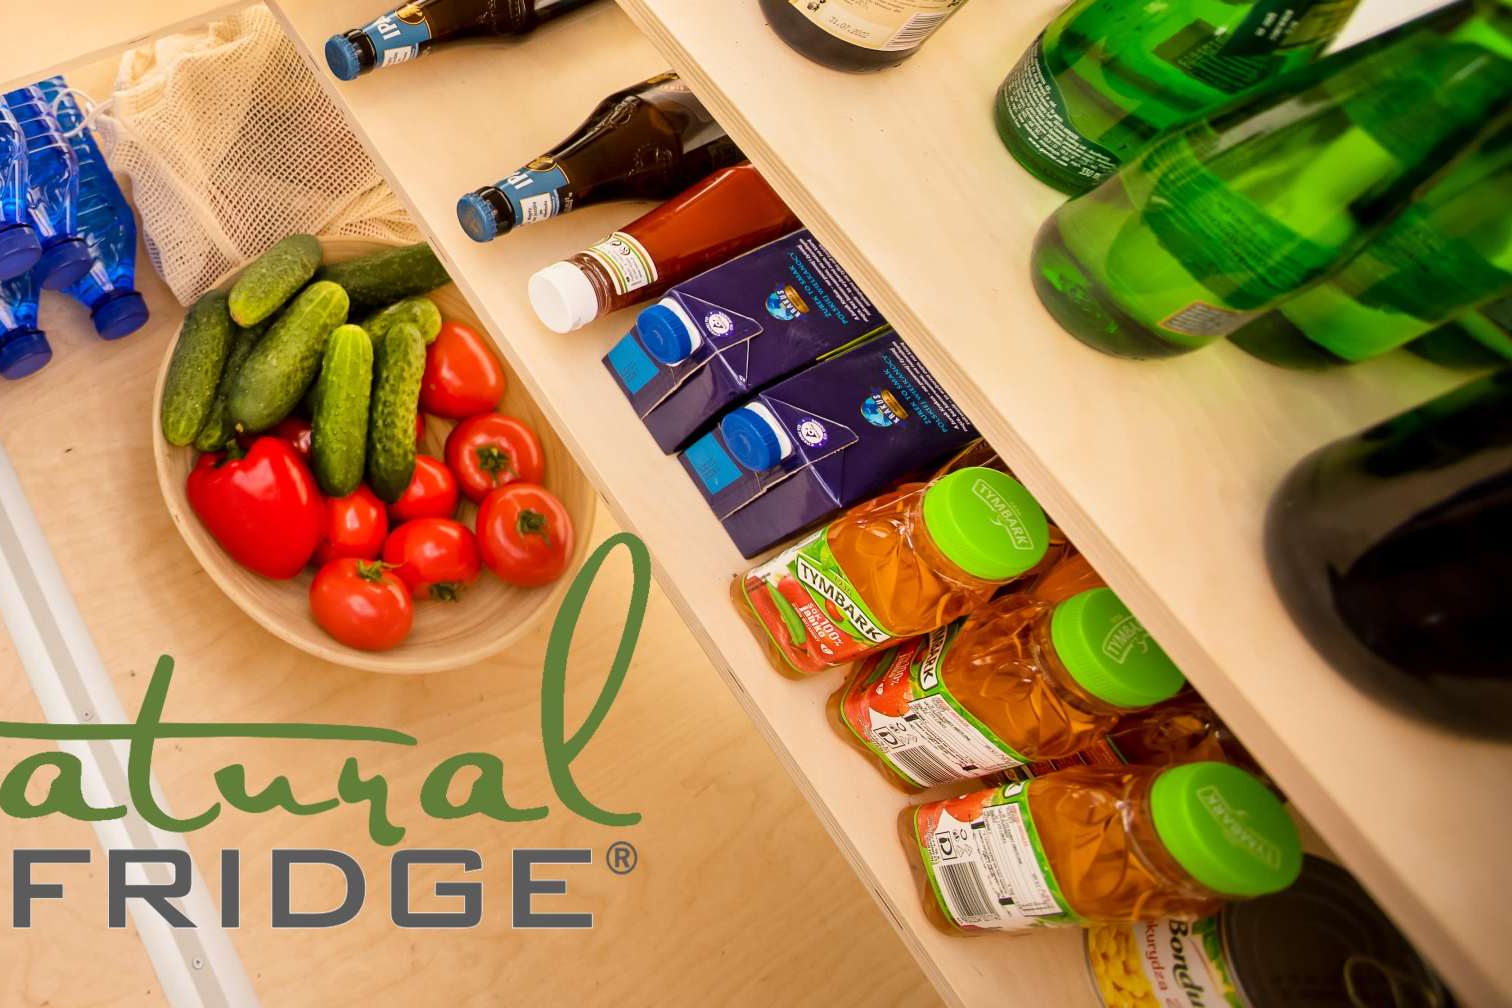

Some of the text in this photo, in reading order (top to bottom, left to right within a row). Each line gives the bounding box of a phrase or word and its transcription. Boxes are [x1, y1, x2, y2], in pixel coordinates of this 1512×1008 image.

[788, 251, 824, 296] WIELKANOCY
[790, 264, 806, 285] SMAK
[777, 290, 801, 318] KRAKUS
[823, 294, 849, 326] POLSKIEJ
[882, 352, 949, 433] POLSKIEJ WIELKANOCY
[883, 368, 903, 389] SMAK
[873, 394, 900, 424] KRAKUS
[979, 483, 1032, 547] TYMBARK
[800, 562, 882, 642] TYMBARK
[820, 617, 844, 647] 100%
[1144, 920, 1169, 993] kurydza
[1169, 918, 1205, 1008] Bondu
